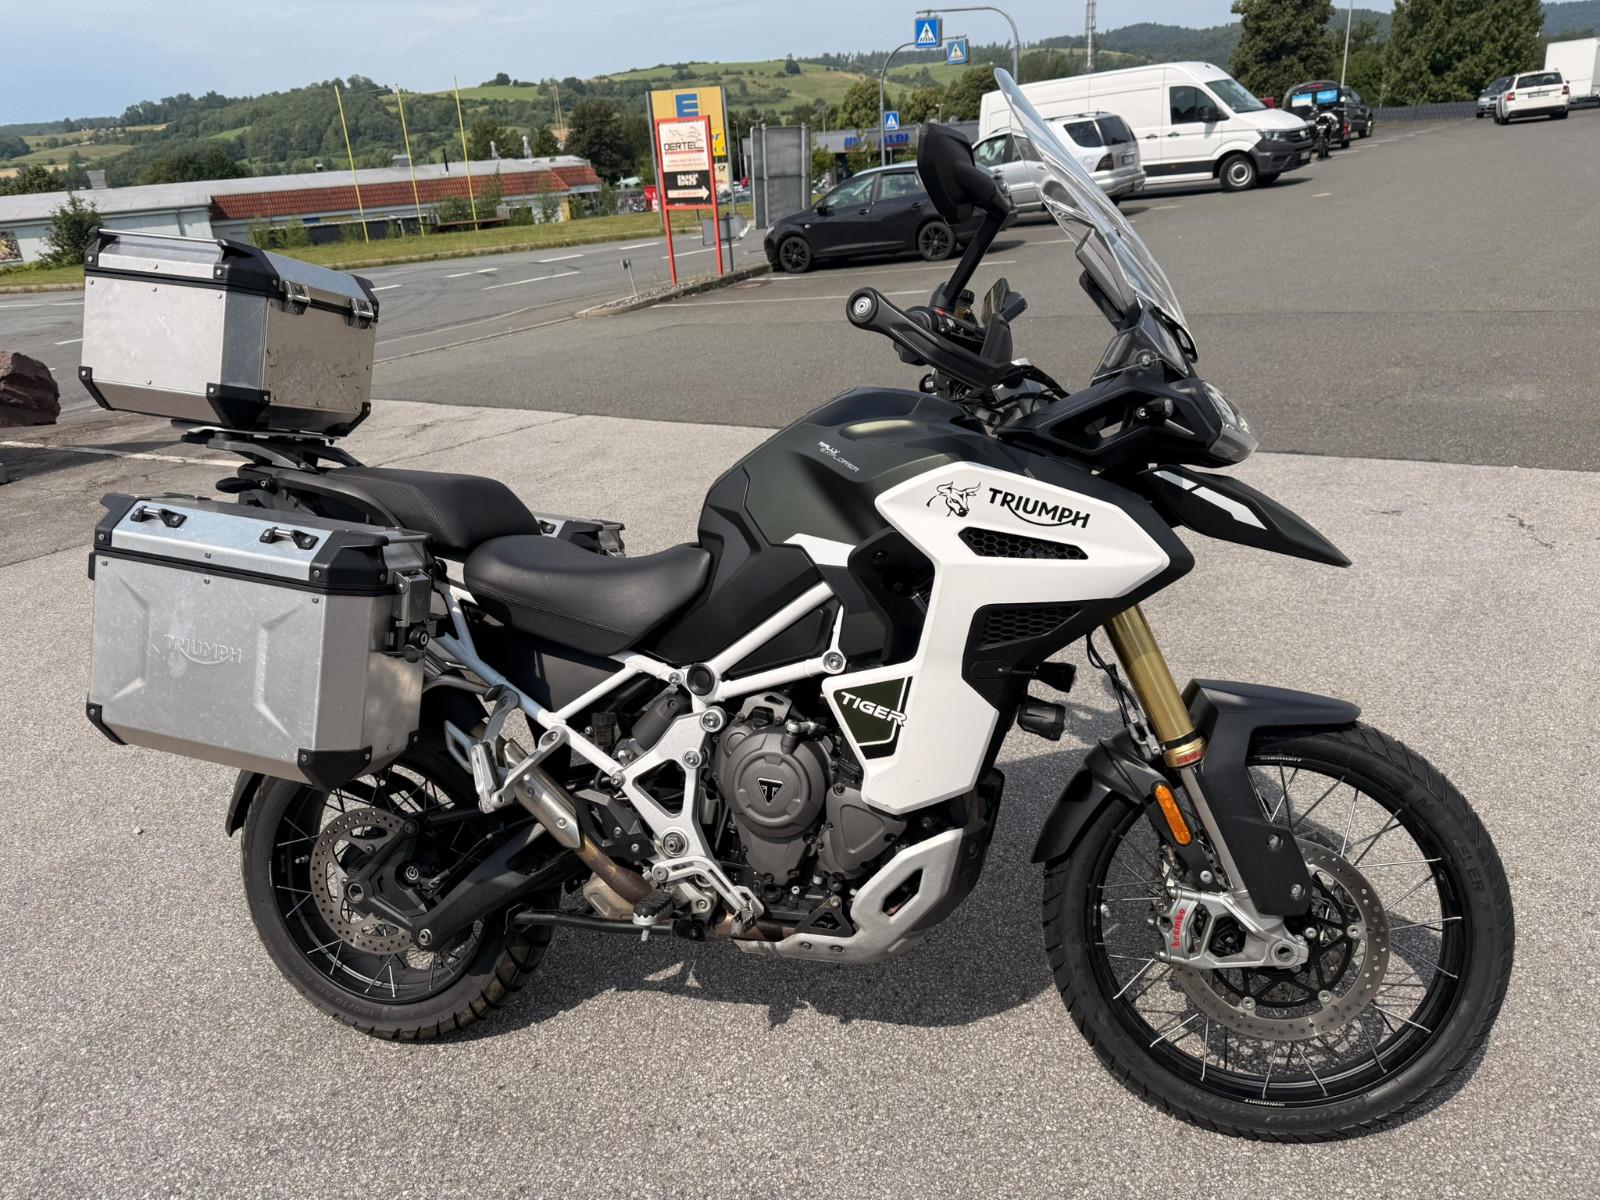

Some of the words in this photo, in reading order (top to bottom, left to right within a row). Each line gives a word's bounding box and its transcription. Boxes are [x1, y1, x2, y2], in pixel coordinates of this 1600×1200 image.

[663, 141, 705, 152] OERTEL
[988, 487, 1091, 529] TRIUMPH
[160, 633, 242, 665] TRIUMPH
[840, 691, 908, 728] TIGER
[1171, 907, 1186, 949] brembo
